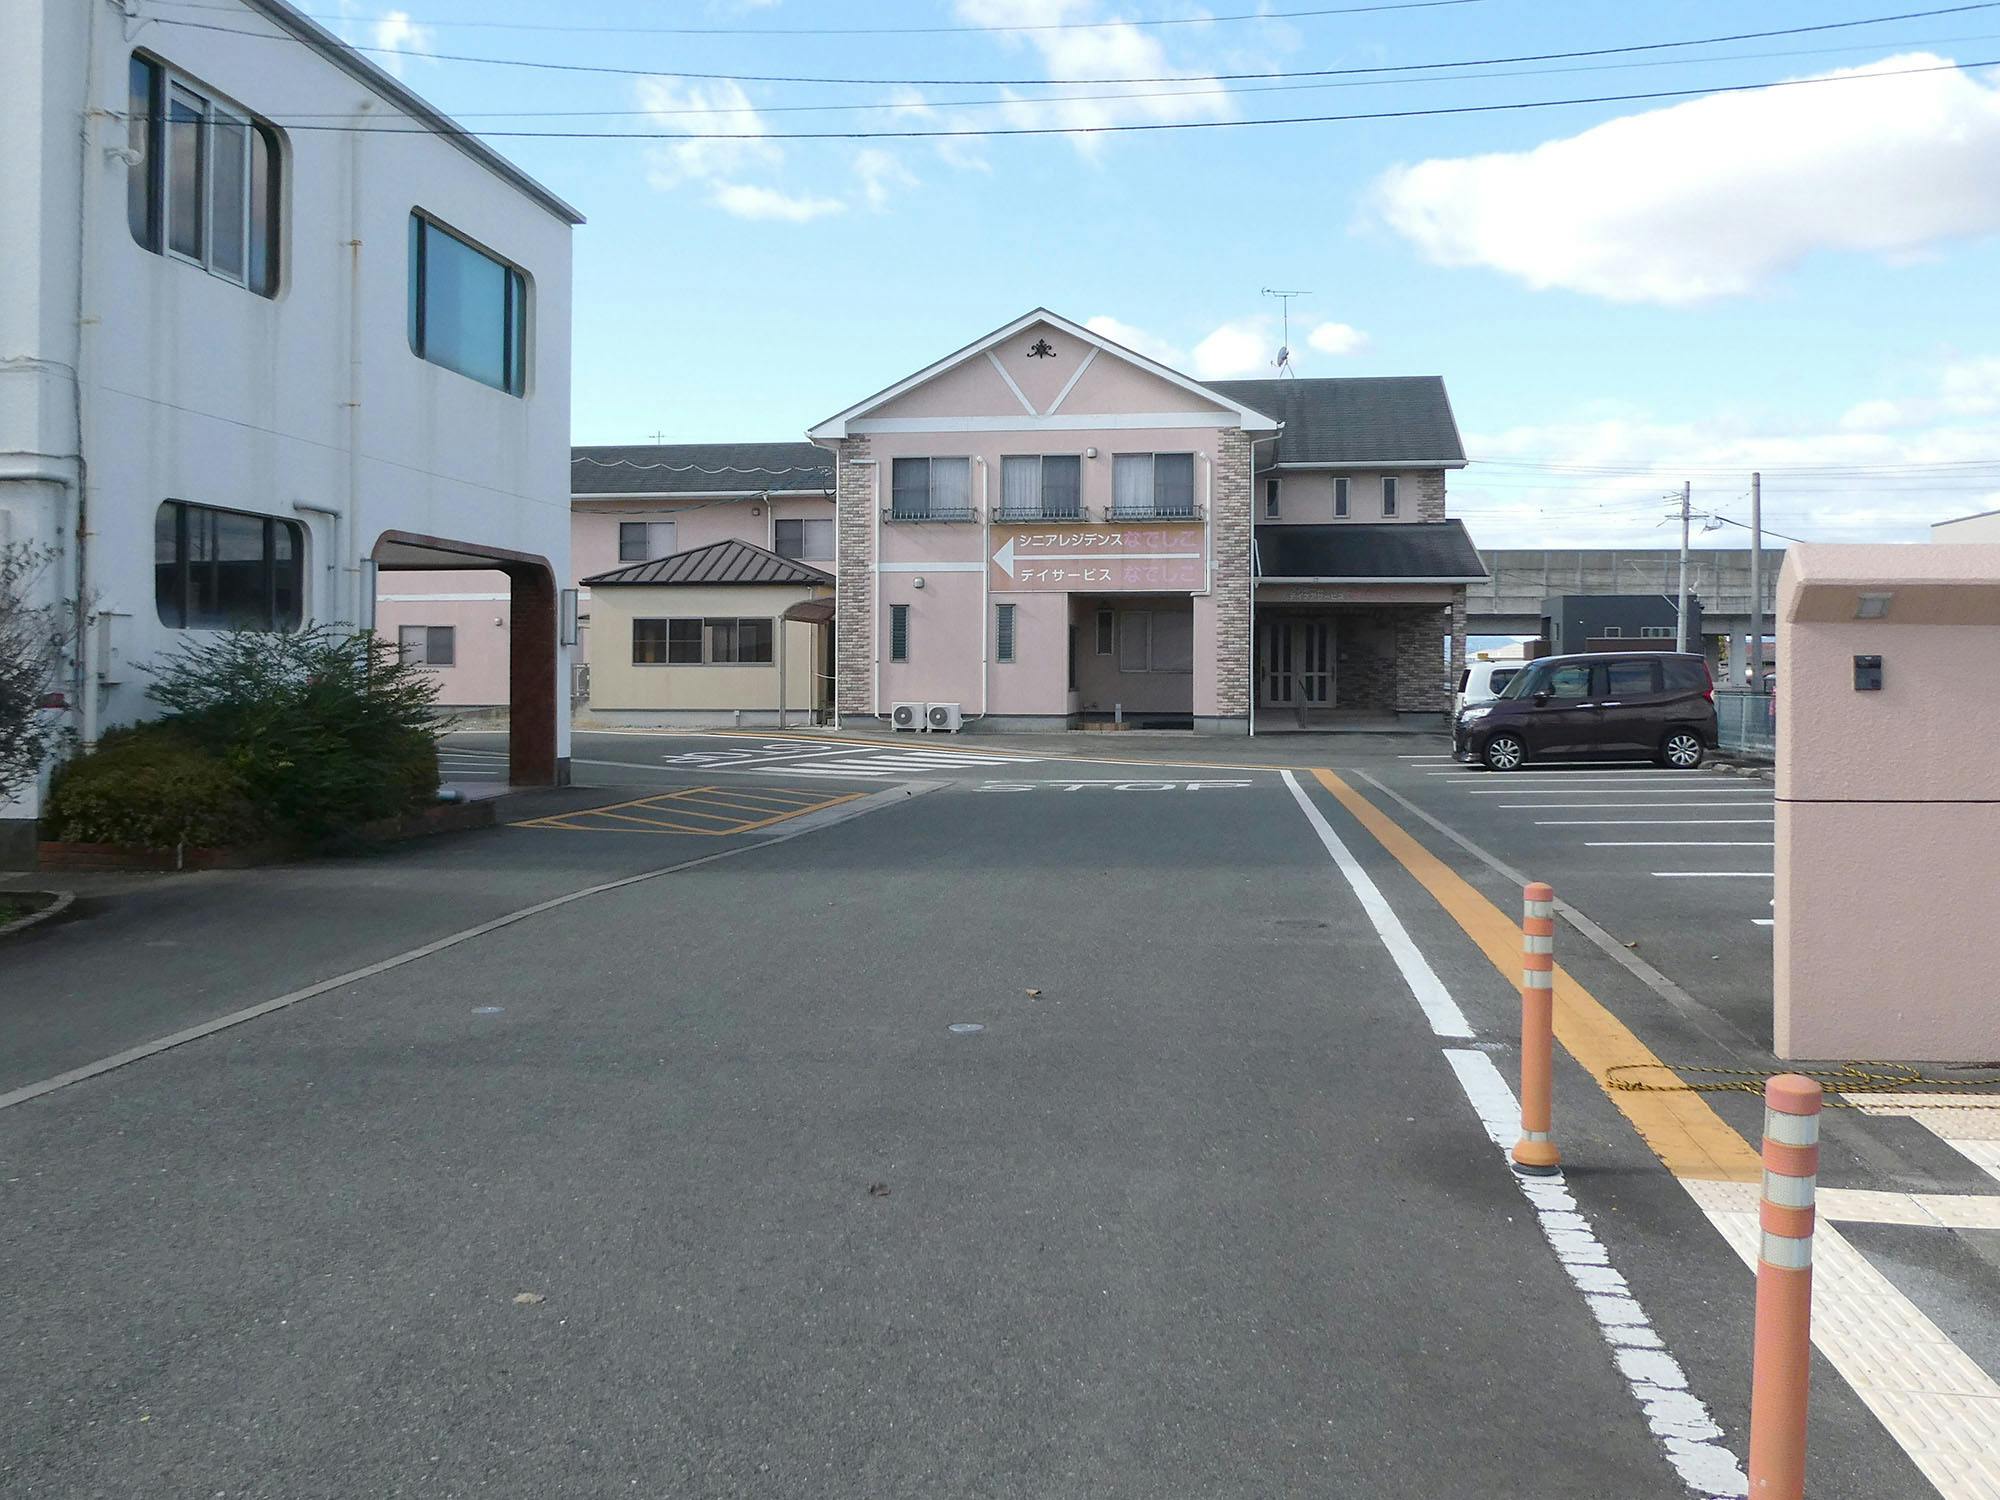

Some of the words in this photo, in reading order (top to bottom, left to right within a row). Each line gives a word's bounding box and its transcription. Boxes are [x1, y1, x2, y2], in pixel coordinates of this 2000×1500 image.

[1019, 533, 1123, 547] シニアレジデンス
[1123, 531, 1197, 548] なでしこ
[1021, 568, 1112, 582] デイサービス
[1123, 566, 1197, 583] なでしこ
[662, 743, 832, 764] STOP
[972, 782, 1250, 792] STOP
